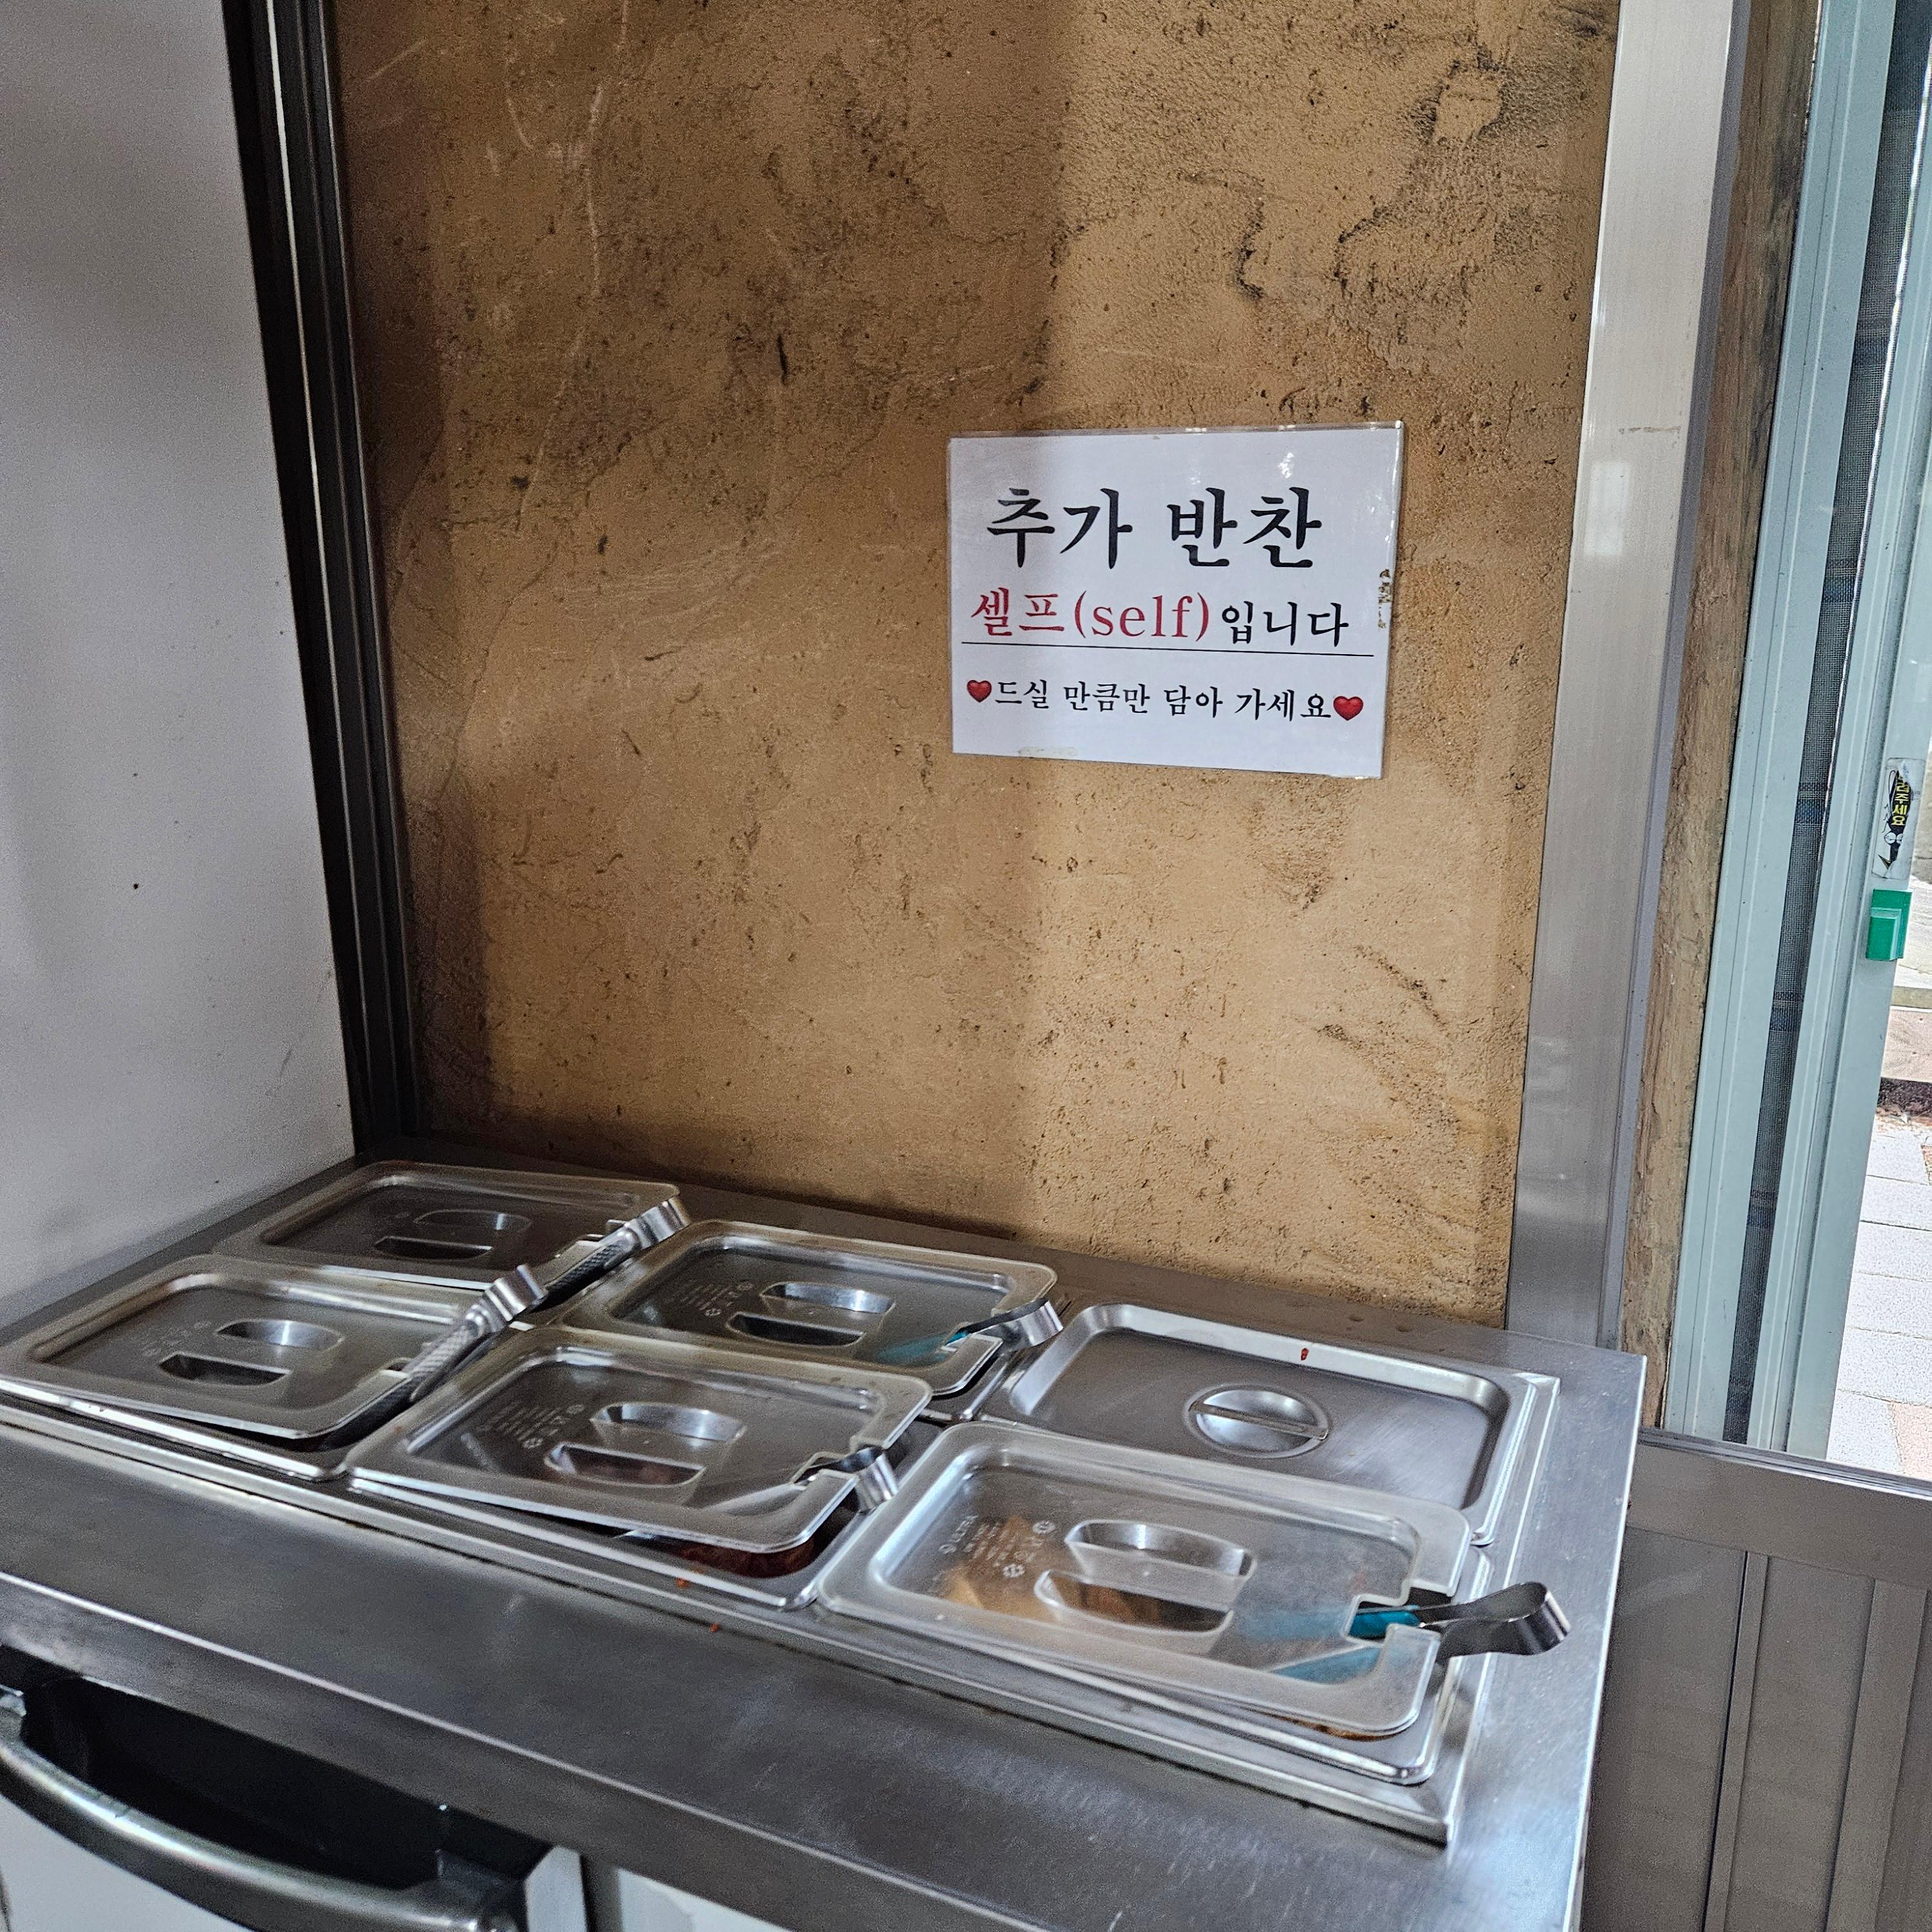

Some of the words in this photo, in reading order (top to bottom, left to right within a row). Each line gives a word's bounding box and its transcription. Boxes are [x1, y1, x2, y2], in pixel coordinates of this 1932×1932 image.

[985, 487, 1134, 570] 추가
[1165, 486, 1323, 569] 반찬
[993, 679, 1049, 709] 드실
[1063, 680, 1151, 714] 만큼만
[1163, 684, 1224, 718] 담아
[1234, 687, 1332, 723] 가세요
[1891, 774, 1910, 826] 려주세요
